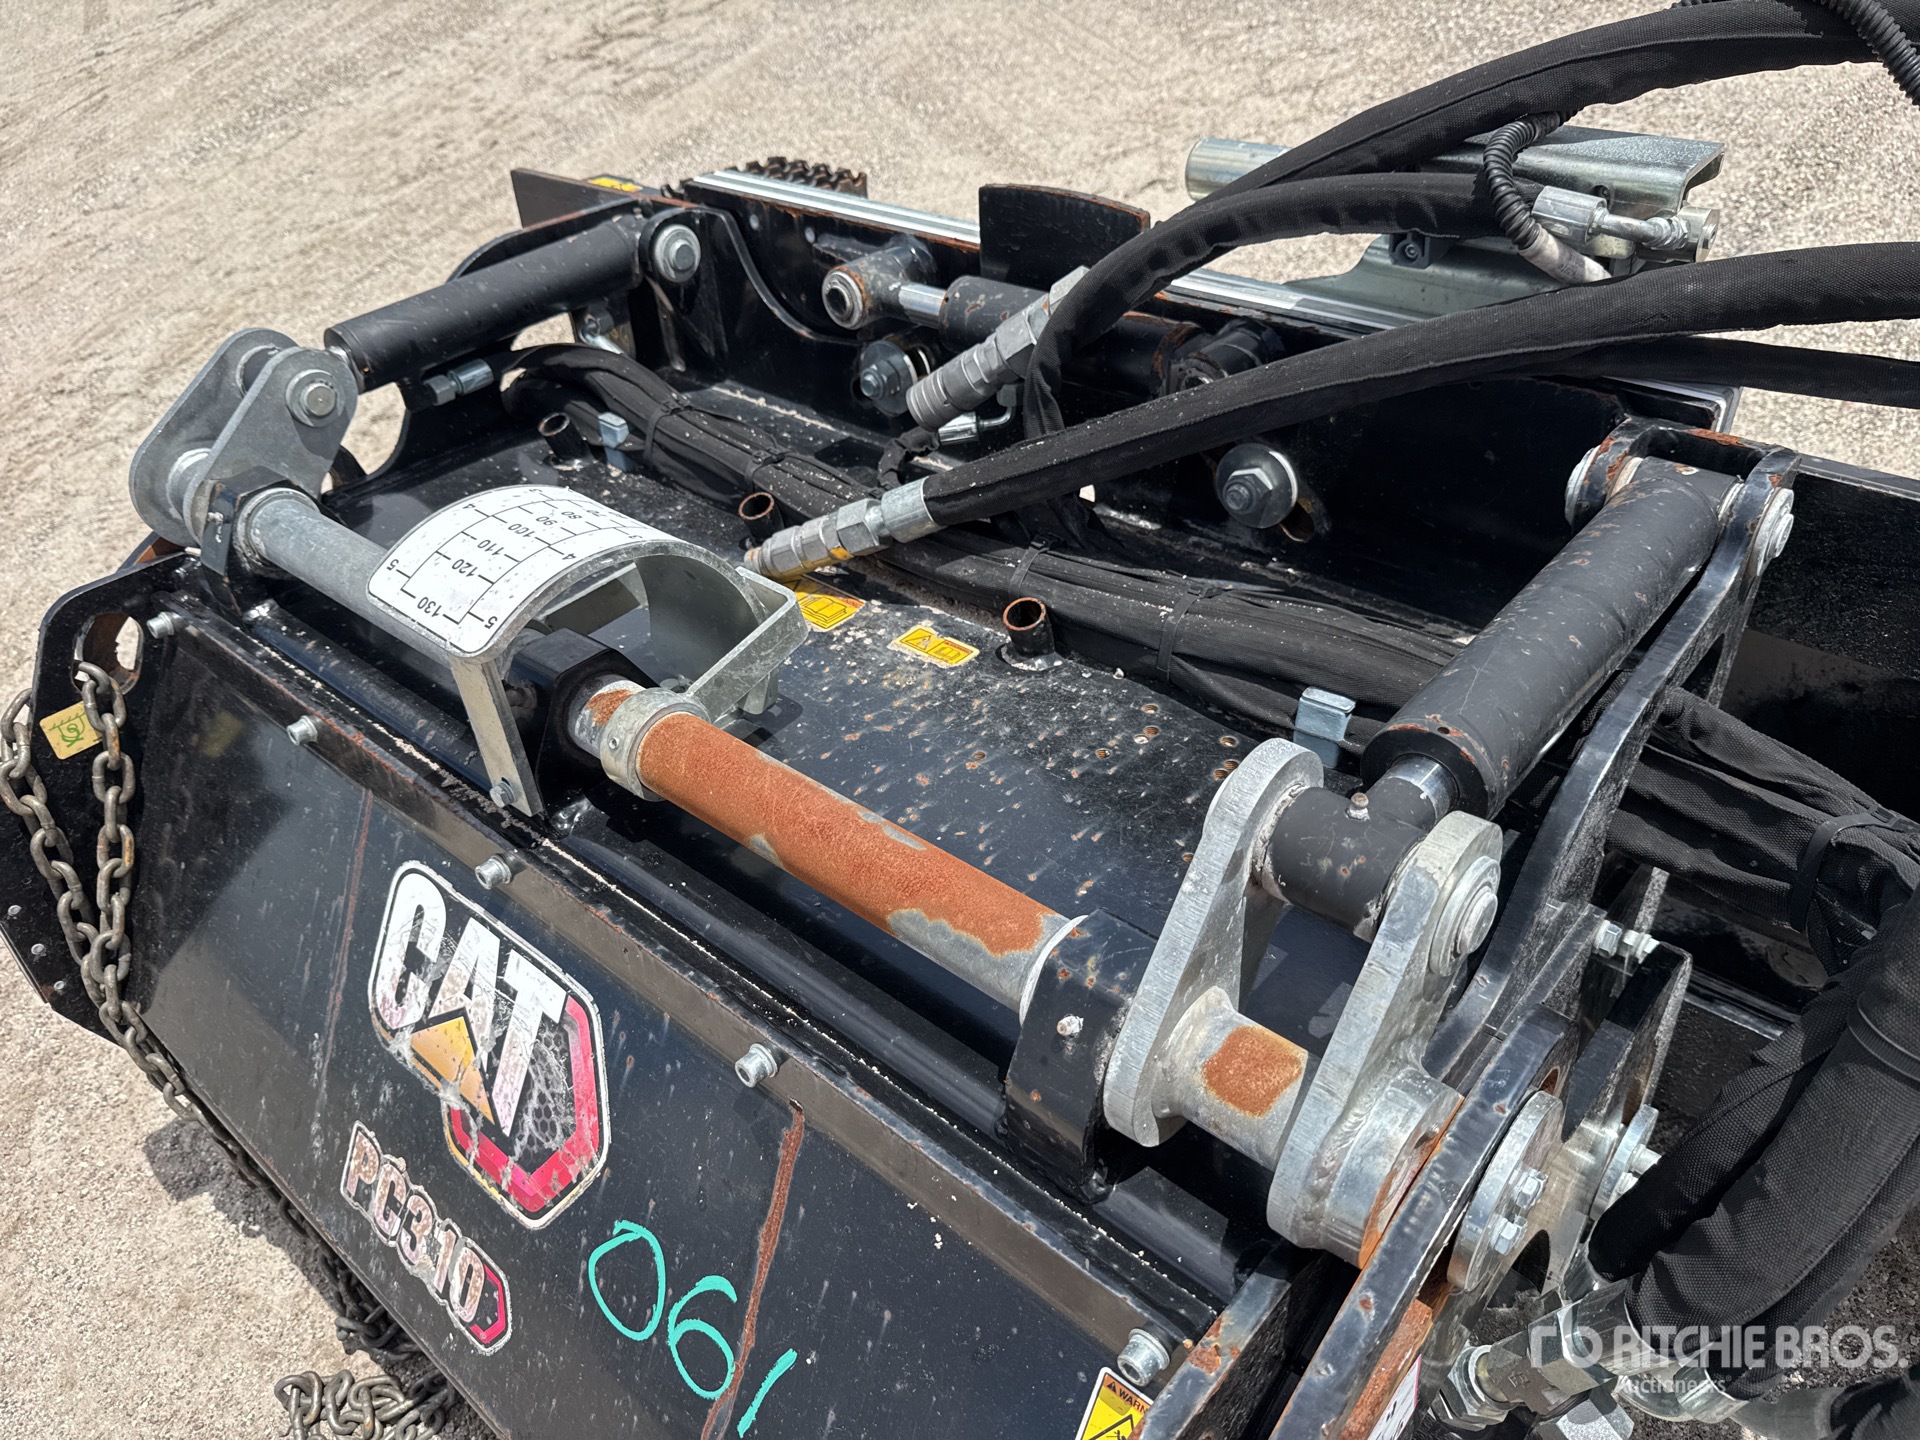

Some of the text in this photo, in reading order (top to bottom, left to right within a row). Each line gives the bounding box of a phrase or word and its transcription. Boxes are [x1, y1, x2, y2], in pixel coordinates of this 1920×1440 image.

[462, 502, 476, 511] 4
[535, 515, 558, 526] 90
[560, 510, 583, 520] 80
[507, 522, 536, 538] 100
[476, 539, 505, 558] 110
[561, 552, 577, 561] 4
[385, 558, 399, 572] 5
[451, 557, 482, 578] 120
[416, 595, 443, 618] 130
[483, 615, 498, 630] 5
[375, 872, 568, 1138] CAT
[346, 1130, 485, 1323] PC310
[1119, 1389, 1148, 1413] WARN
